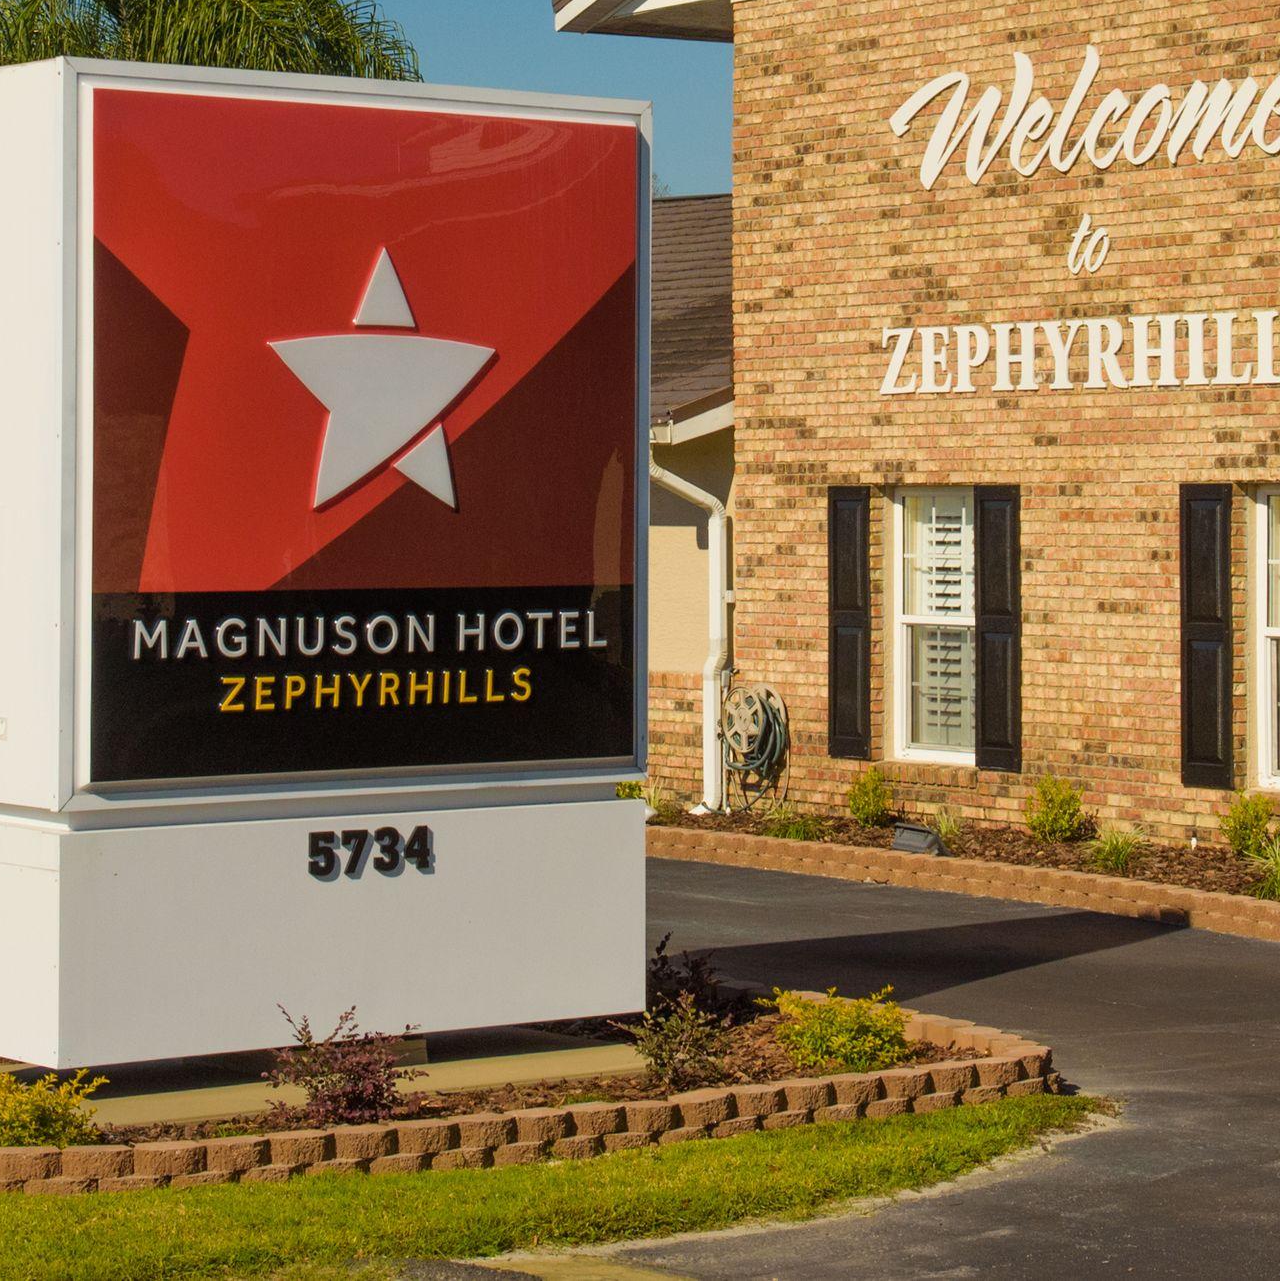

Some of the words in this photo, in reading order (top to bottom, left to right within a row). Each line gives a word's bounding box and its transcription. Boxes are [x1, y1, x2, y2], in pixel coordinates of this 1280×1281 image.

[1067, 213, 1111, 275] to
[132, 613, 436, 660] MAGNUSON
[457, 610, 609, 653] HOTEL
[218, 667, 533, 712] ZEPHYRHILLS
[308, 825, 433, 881] 5734
